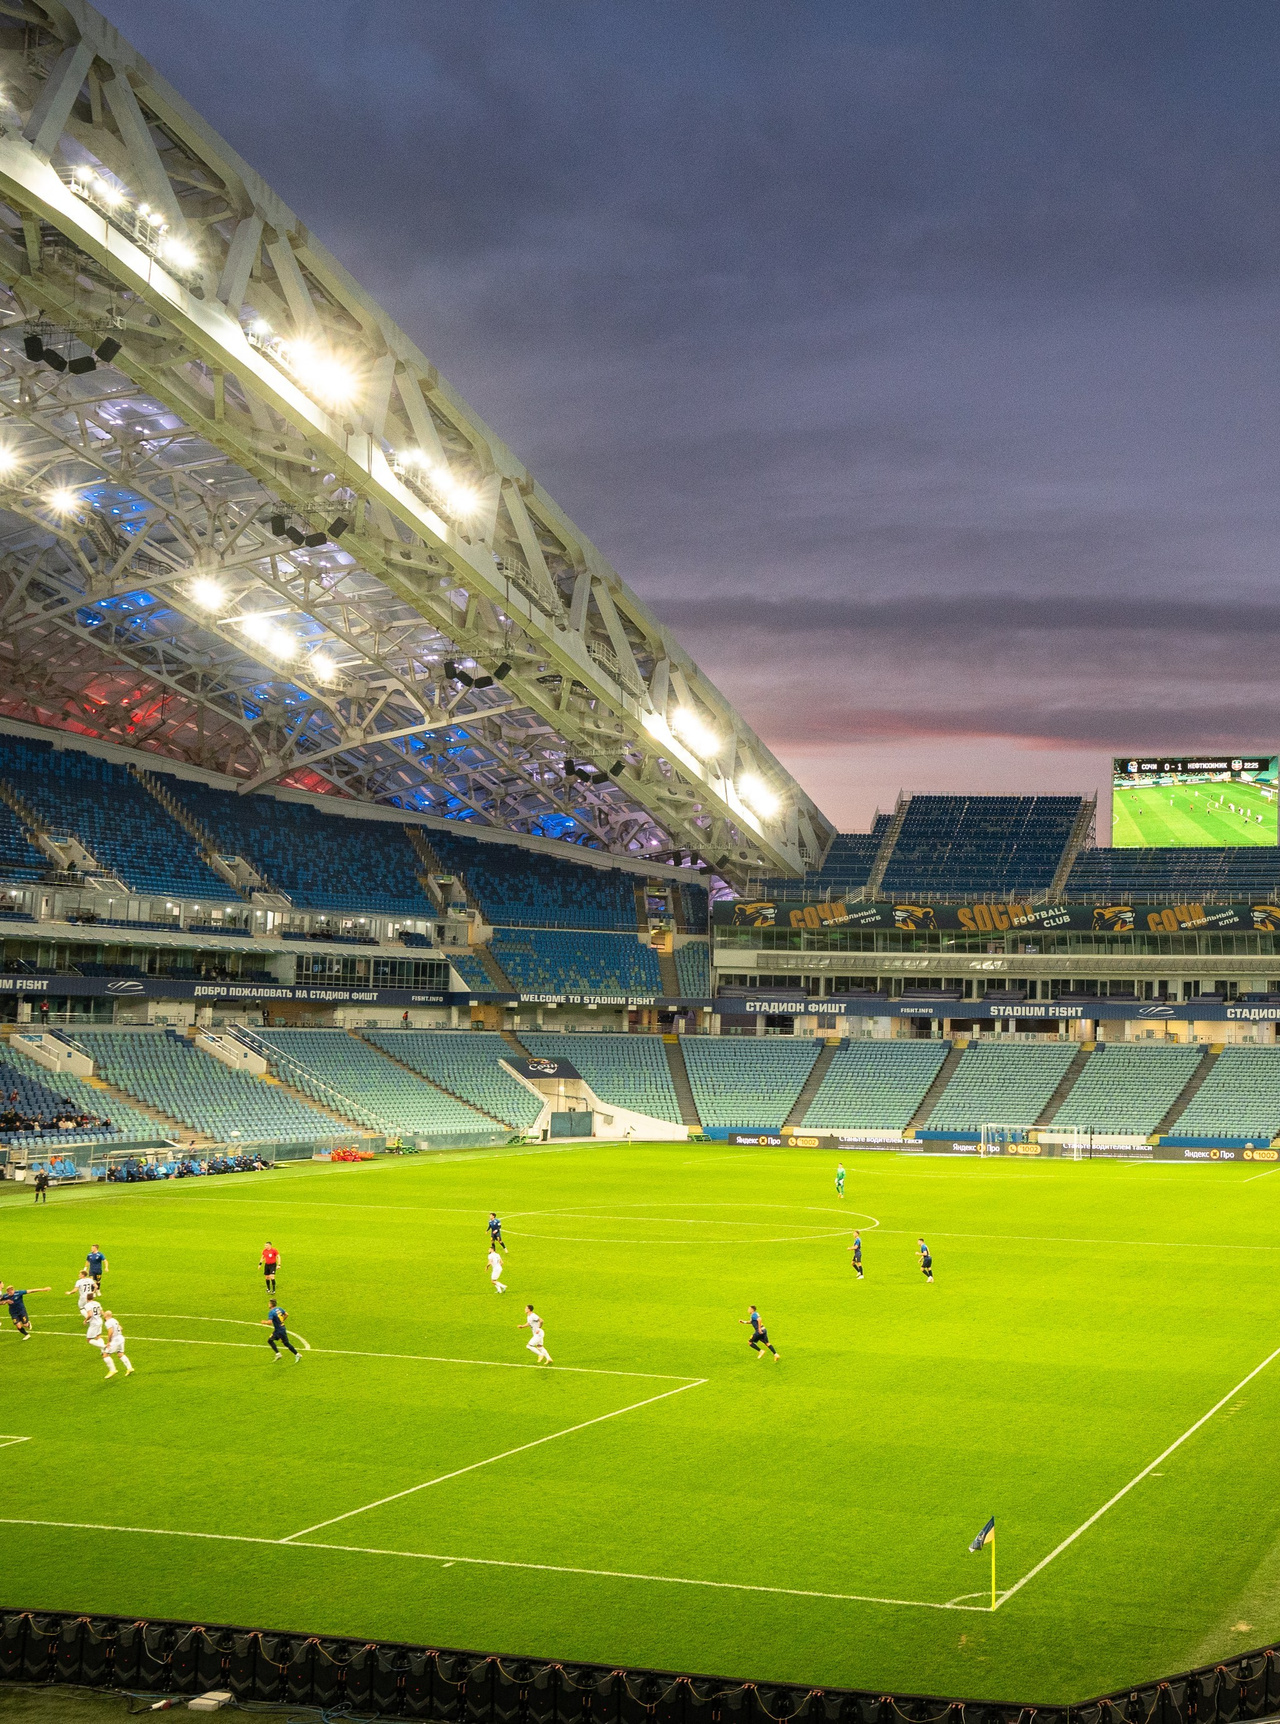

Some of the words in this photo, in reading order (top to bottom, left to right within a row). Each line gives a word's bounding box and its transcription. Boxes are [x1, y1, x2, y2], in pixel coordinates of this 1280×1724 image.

[789, 903, 850, 928] СОЧИ
[822, 908, 877, 926] ФУТБОЛЬНЫЙ
[860, 915, 881, 924] КЛУБ
[957, 904, 1036, 930] SOCHI
[1013, 906, 1067, 925] FOOTBALL
[1043, 915, 1071, 928] CLUB
[1147, 904, 1208, 931] СОЧИ
[1180, 909, 1234, 928] ФУТБОЛЬНЫЙ
[1219, 917, 1239, 926] КЛУБ
[16, 980, 49, 990] FISHT
[194, 985, 227, 997] ДОБРО
[229, 986, 293, 998] ПОЖАЛОВАТЬ
[295, 989, 308, 998] НА
[310, 990, 350, 1001] СТАДИОН
[351, 991, 378, 1001] ФИШТ
[520, 994, 566, 1003] WELCOME
[568, 995, 581, 1004] TO
[583, 996, 626, 1005] STADIUM
[628, 996, 656, 1005] FISHT
[745, 1002, 804, 1014] СТАДИОН
[808, 1002, 847, 1013] ФИШТ
[990, 1006, 1045, 1016] STADIUM
[1048, 1006, 1083, 1017] FISHT
[736, 1136, 758, 1145] Яндекс
[767, 1137, 781, 1145] Про
[952, 1143, 976, 1152] Яндекс
[986, 1144, 1000, 1153] Про
[1184, 1150, 1209, 1158] Яндекс
[1220, 1151, 1235, 1159] Про
